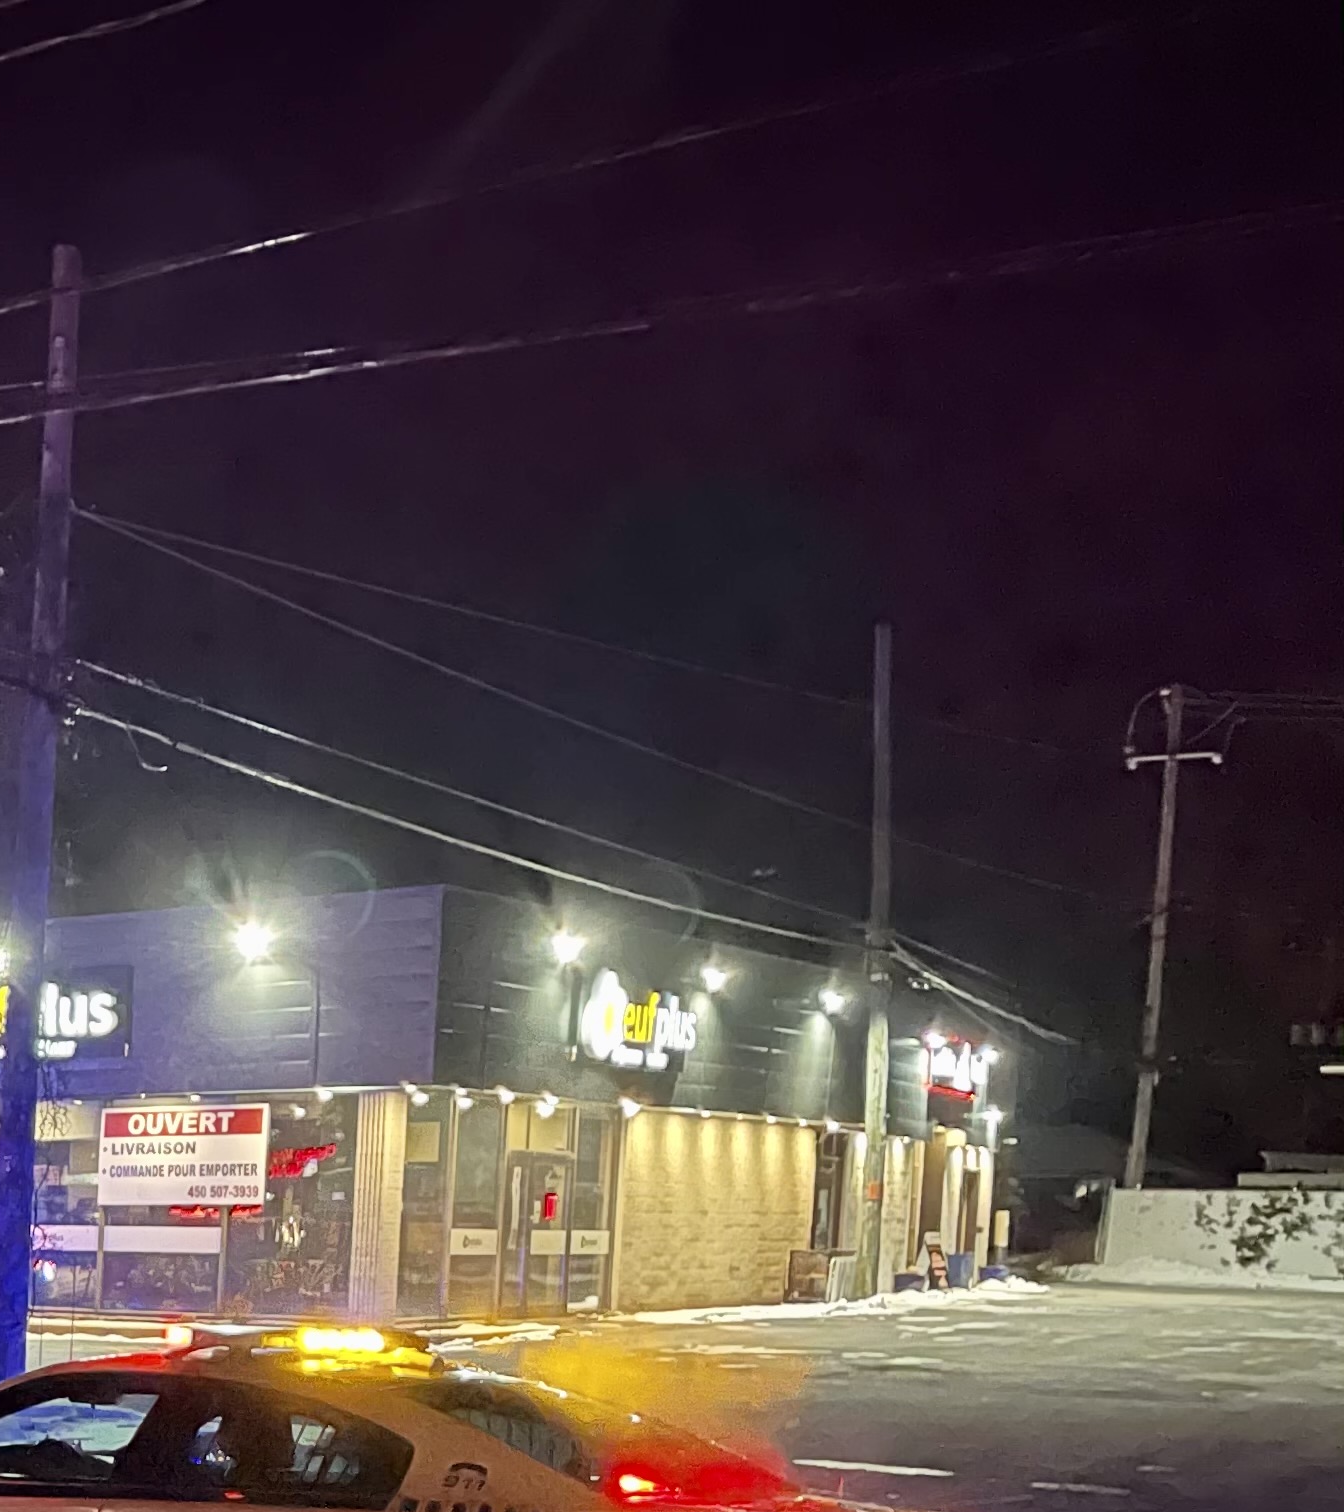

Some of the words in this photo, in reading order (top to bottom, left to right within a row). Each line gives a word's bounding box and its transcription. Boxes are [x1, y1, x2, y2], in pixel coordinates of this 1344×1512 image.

[127, 1111, 235, 1135] OUVERT
[111, 1141, 197, 1156] LIVRAISON
[109, 1164, 165, 1178] COMMANDE
[167, 1163, 197, 1178] POUR
[199, 1162, 258, 1177] EMPORTER
[187, 1185, 207, 1199] 450
[210, 1185, 259, 1199] 507-3939
